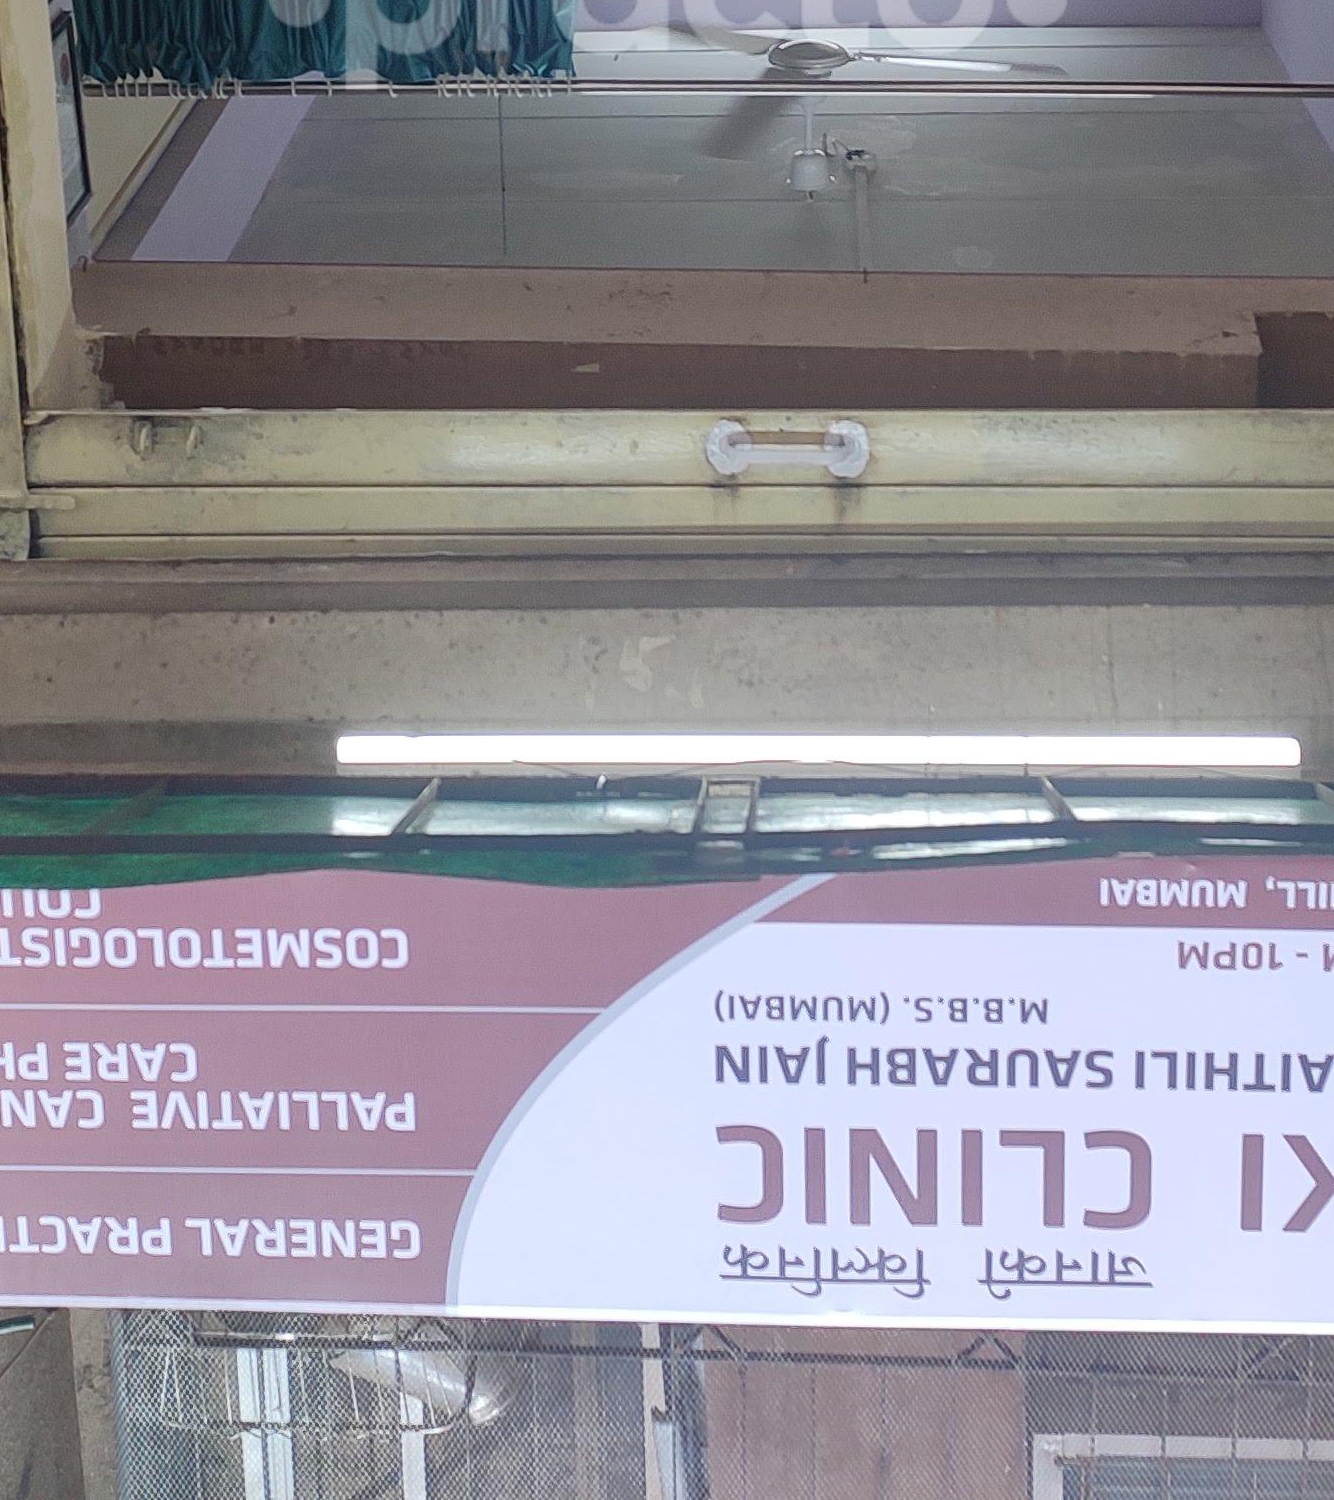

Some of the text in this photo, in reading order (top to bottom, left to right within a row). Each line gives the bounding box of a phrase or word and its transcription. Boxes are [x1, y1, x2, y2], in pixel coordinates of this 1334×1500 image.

[1098, 876, 1248, 909] MUMBAI
[1175, 940, 1283, 971] 10PM
[713, 988, 1051, 1026] M.B.B.S. (MUMBAI)
[63, 1040, 199, 1082] CARE
[714, 1035, 829, 1087] JAIN
[846, 1043, 1114, 1089] SAURABH
[130, 1088, 417, 1133] PALLIATIVE
[715, 1124, 1154, 1231] CLINIC
[184, 1216, 423, 1260] GENERAL
[718, 1244, 1152, 1300] जानकी क्लिनिक
